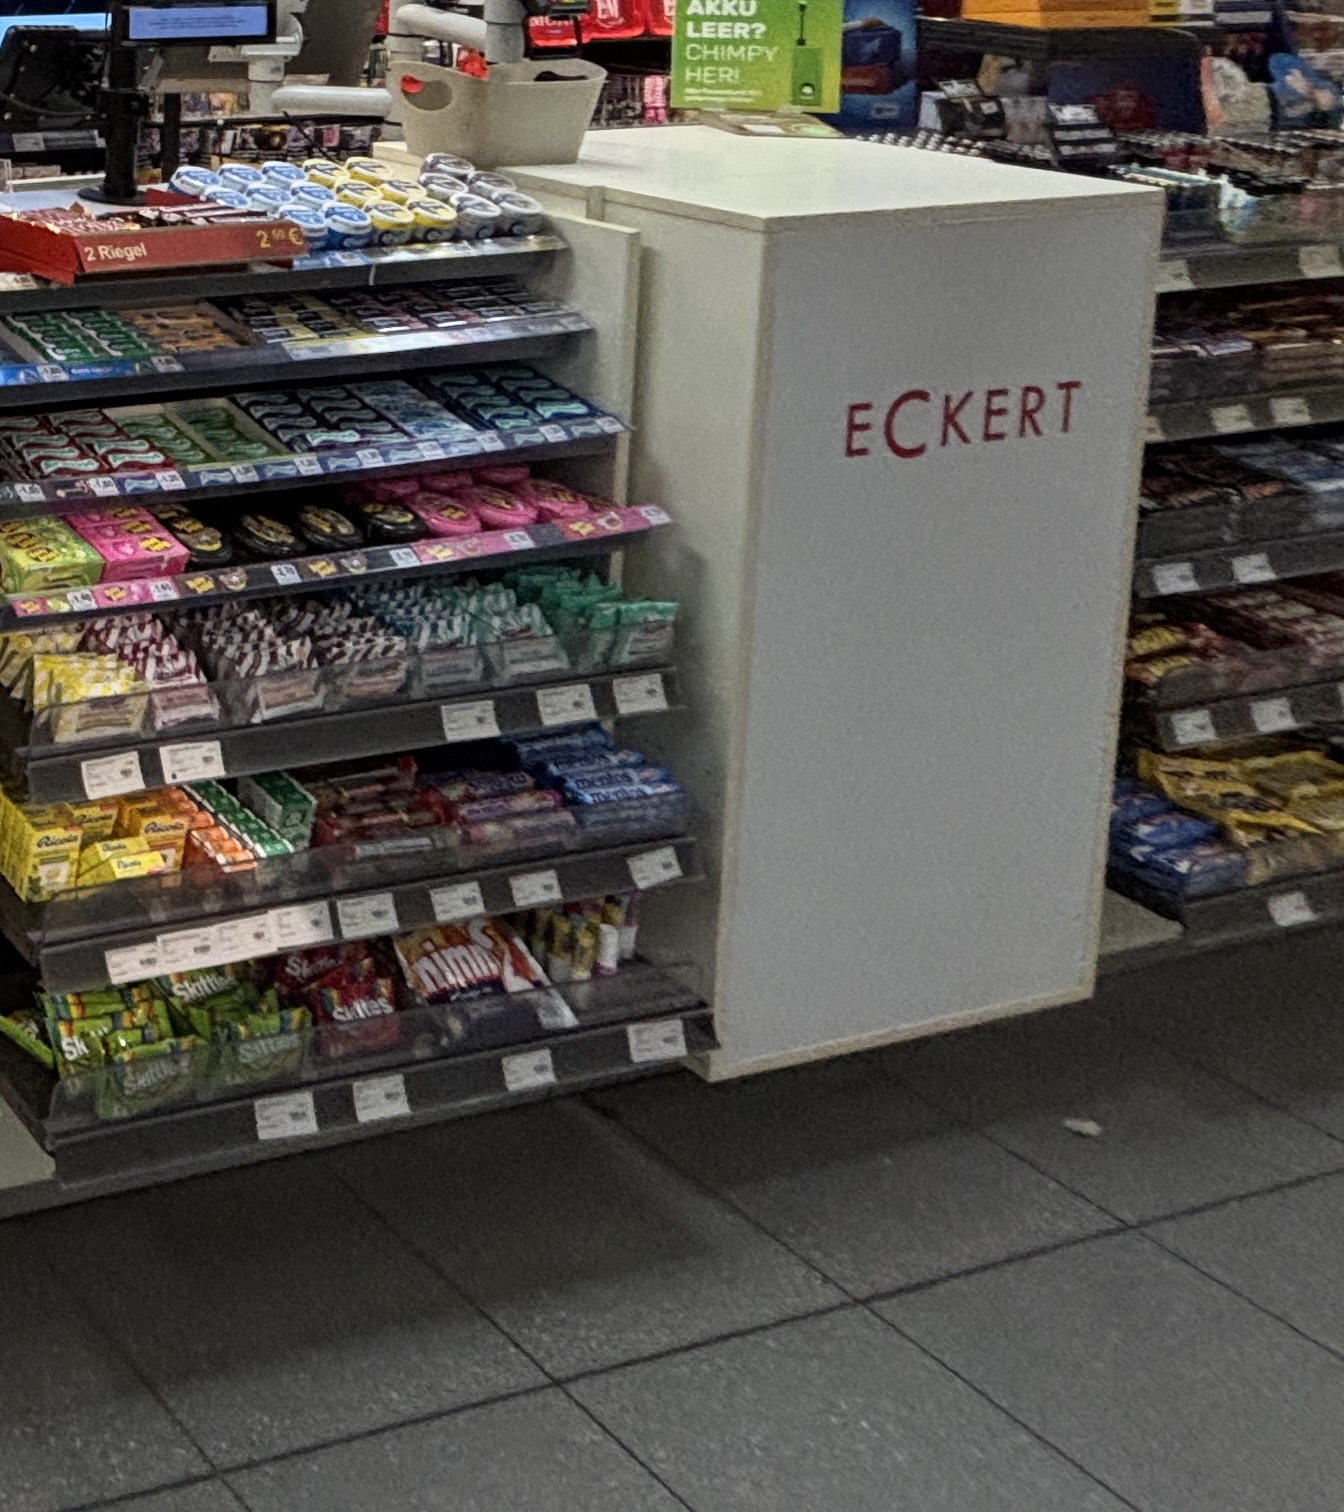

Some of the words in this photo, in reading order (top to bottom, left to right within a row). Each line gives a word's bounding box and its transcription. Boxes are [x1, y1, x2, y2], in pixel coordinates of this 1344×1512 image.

[686, 20, 767, 41] LEER?
[684, 43, 780, 64] CHIMPY
[84, 246, 98, 262] 2
[99, 241, 148, 262] Riegel
[844, 380, 1082, 459] ECKERT
[575, 770, 633, 789] mentos
